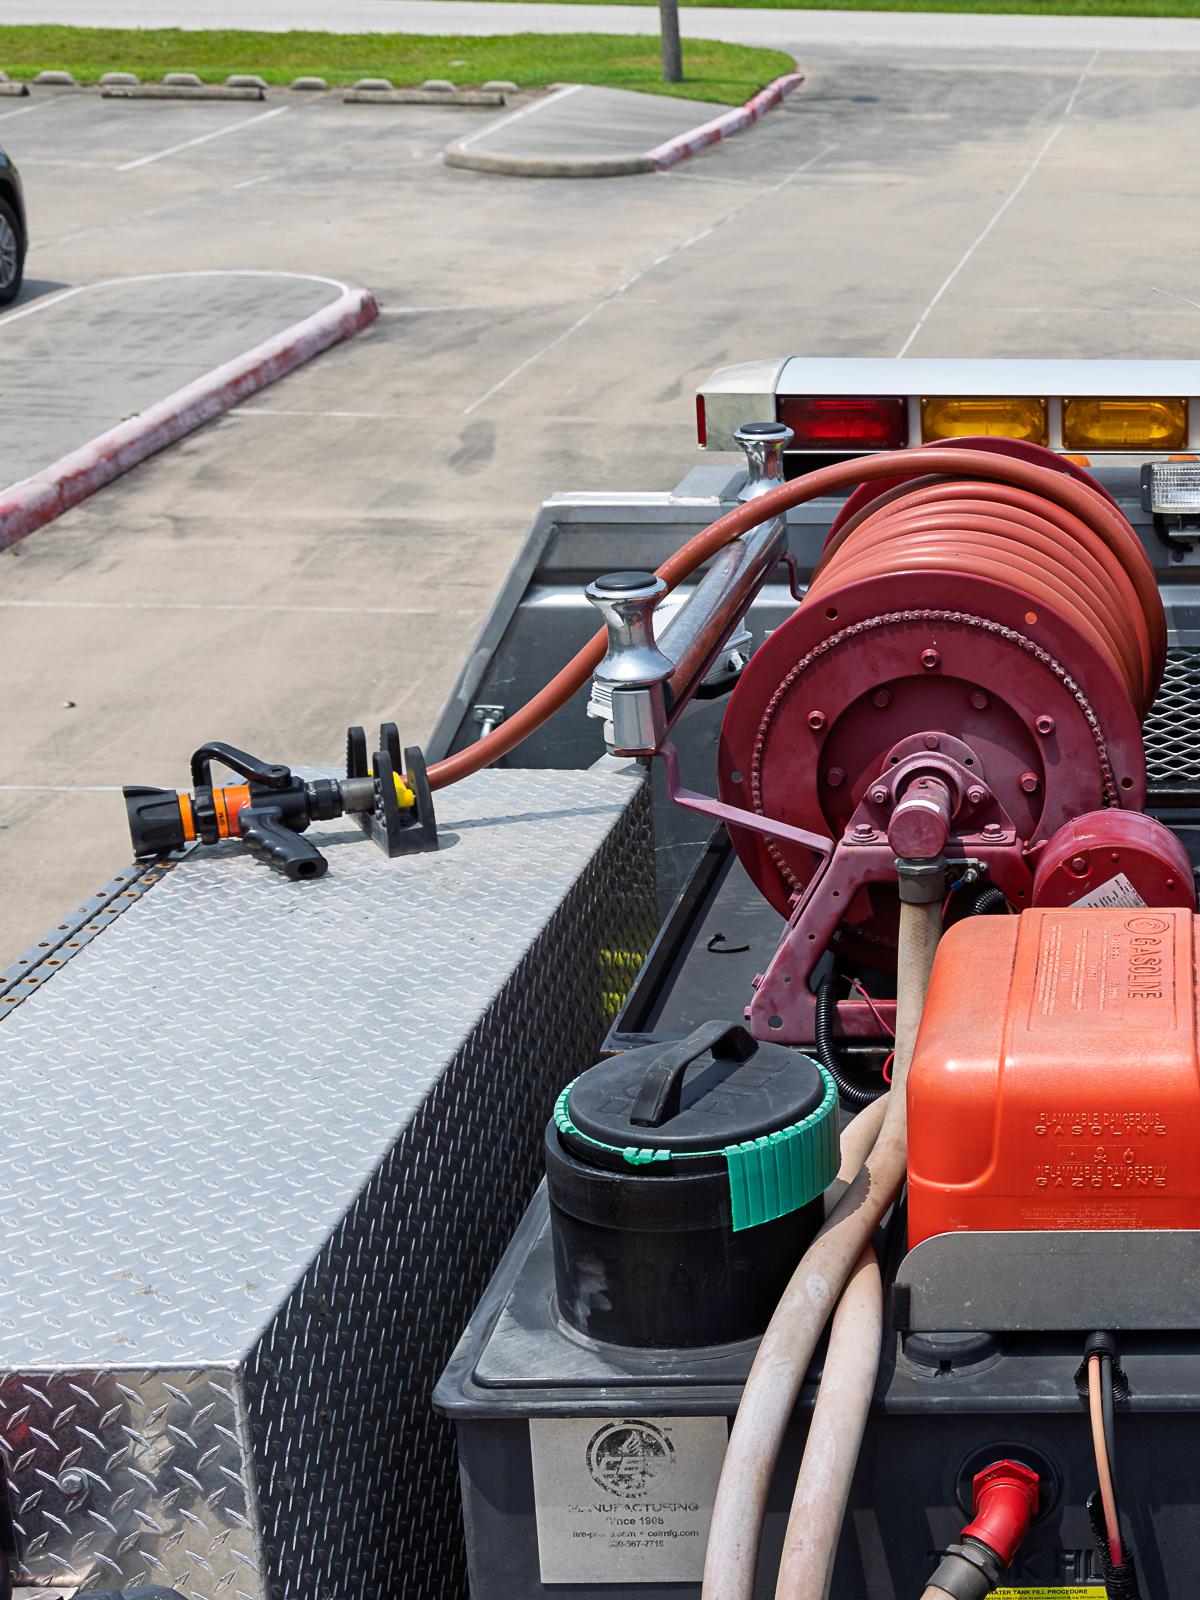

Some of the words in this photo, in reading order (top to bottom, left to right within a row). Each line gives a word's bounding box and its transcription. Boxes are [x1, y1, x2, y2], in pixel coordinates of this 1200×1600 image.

[1127, 937, 1163, 999] GASOLINE
[1040, 1112, 1099, 1126] FLAMMABLE
[1103, 1112, 1161, 1126] DANGEROUS
[1034, 1125, 1167, 1135] GASOLINE
[1034, 1165, 1103, 1178] INFLAMMABLE
[1106, 1165, 1167, 1178] DANGEREUX
[1035, 1177, 1166, 1187] GAZOLINE
[639, 1516, 665, 1525] 1908
[1053, 1549, 1106, 1583] FIL
